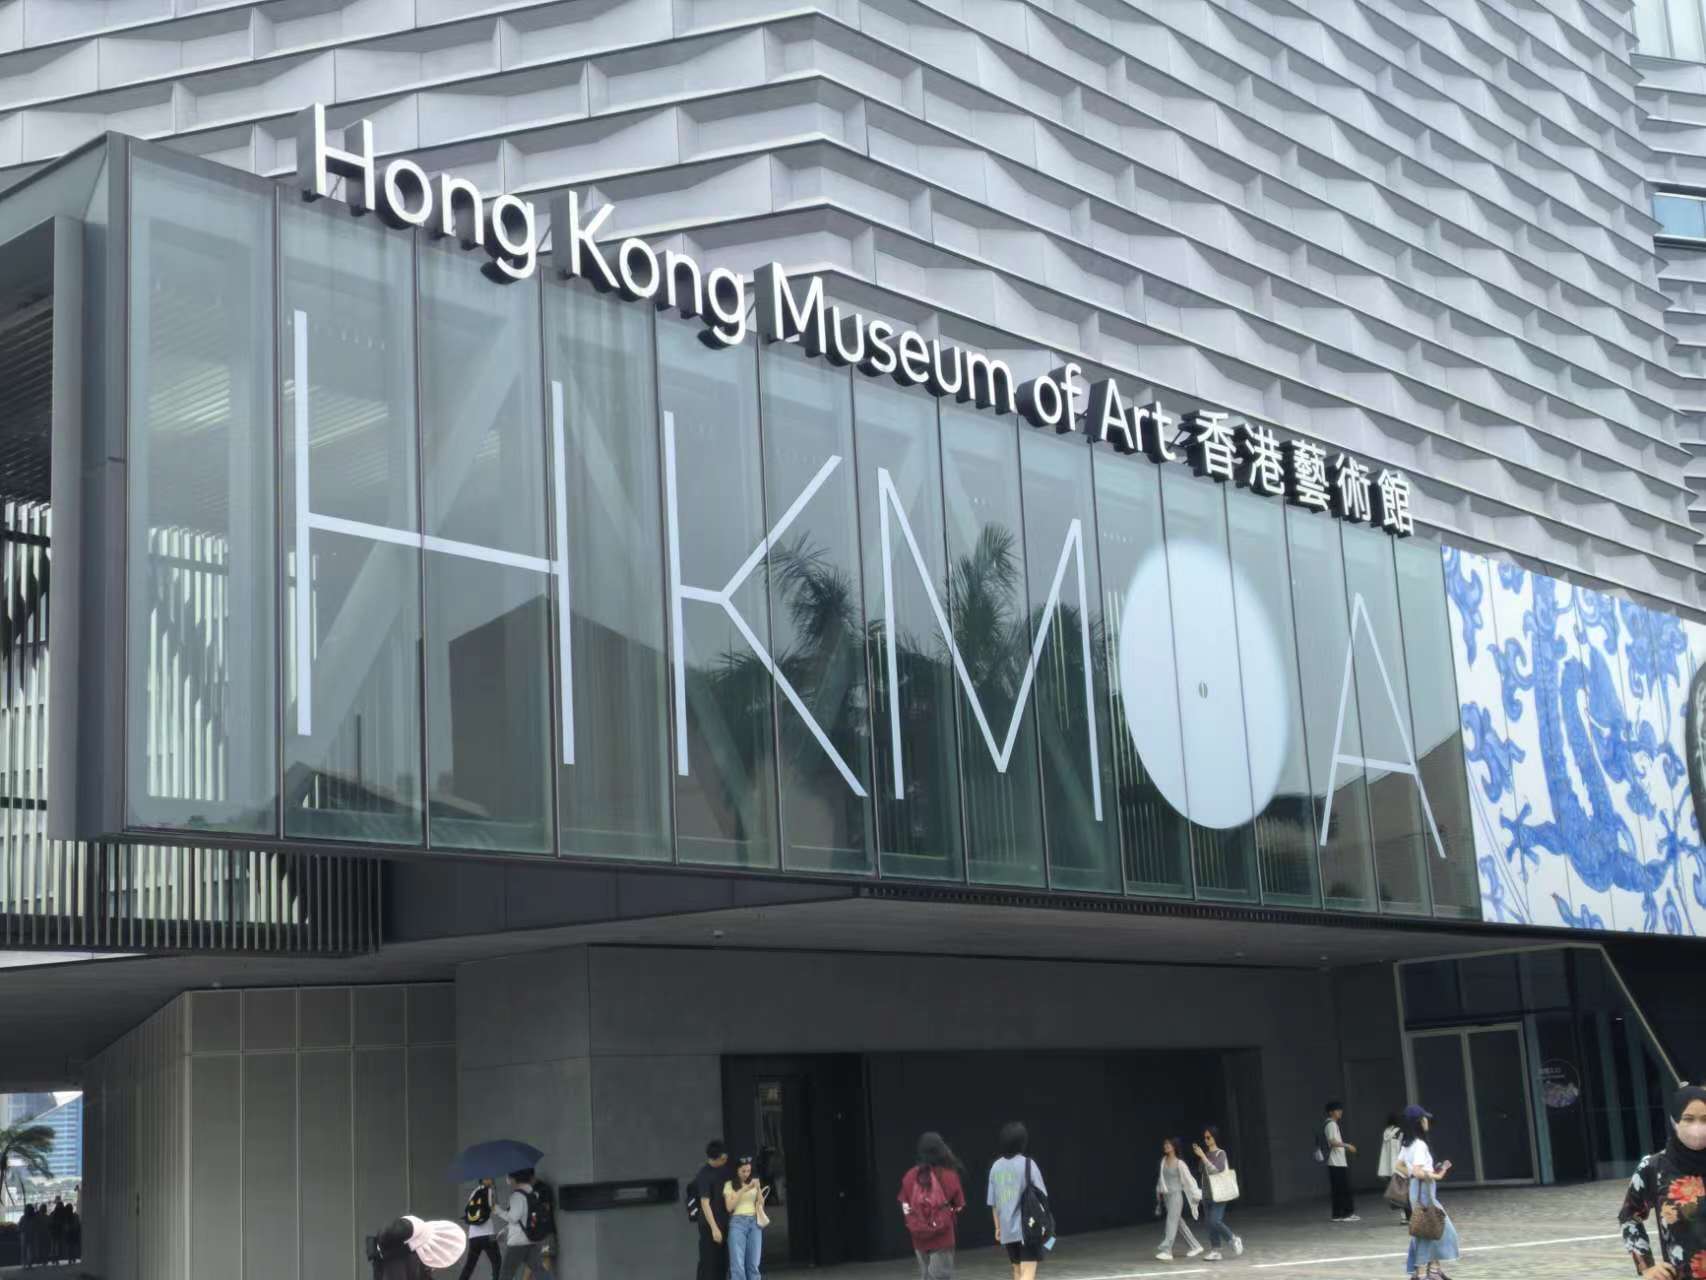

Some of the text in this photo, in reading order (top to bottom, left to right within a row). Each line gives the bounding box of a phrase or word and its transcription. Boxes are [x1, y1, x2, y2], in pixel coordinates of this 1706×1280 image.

[312, 102, 1176, 461] Hong Kong Museum of Art
[1196, 410, 1415, 536] 香港藝術館
